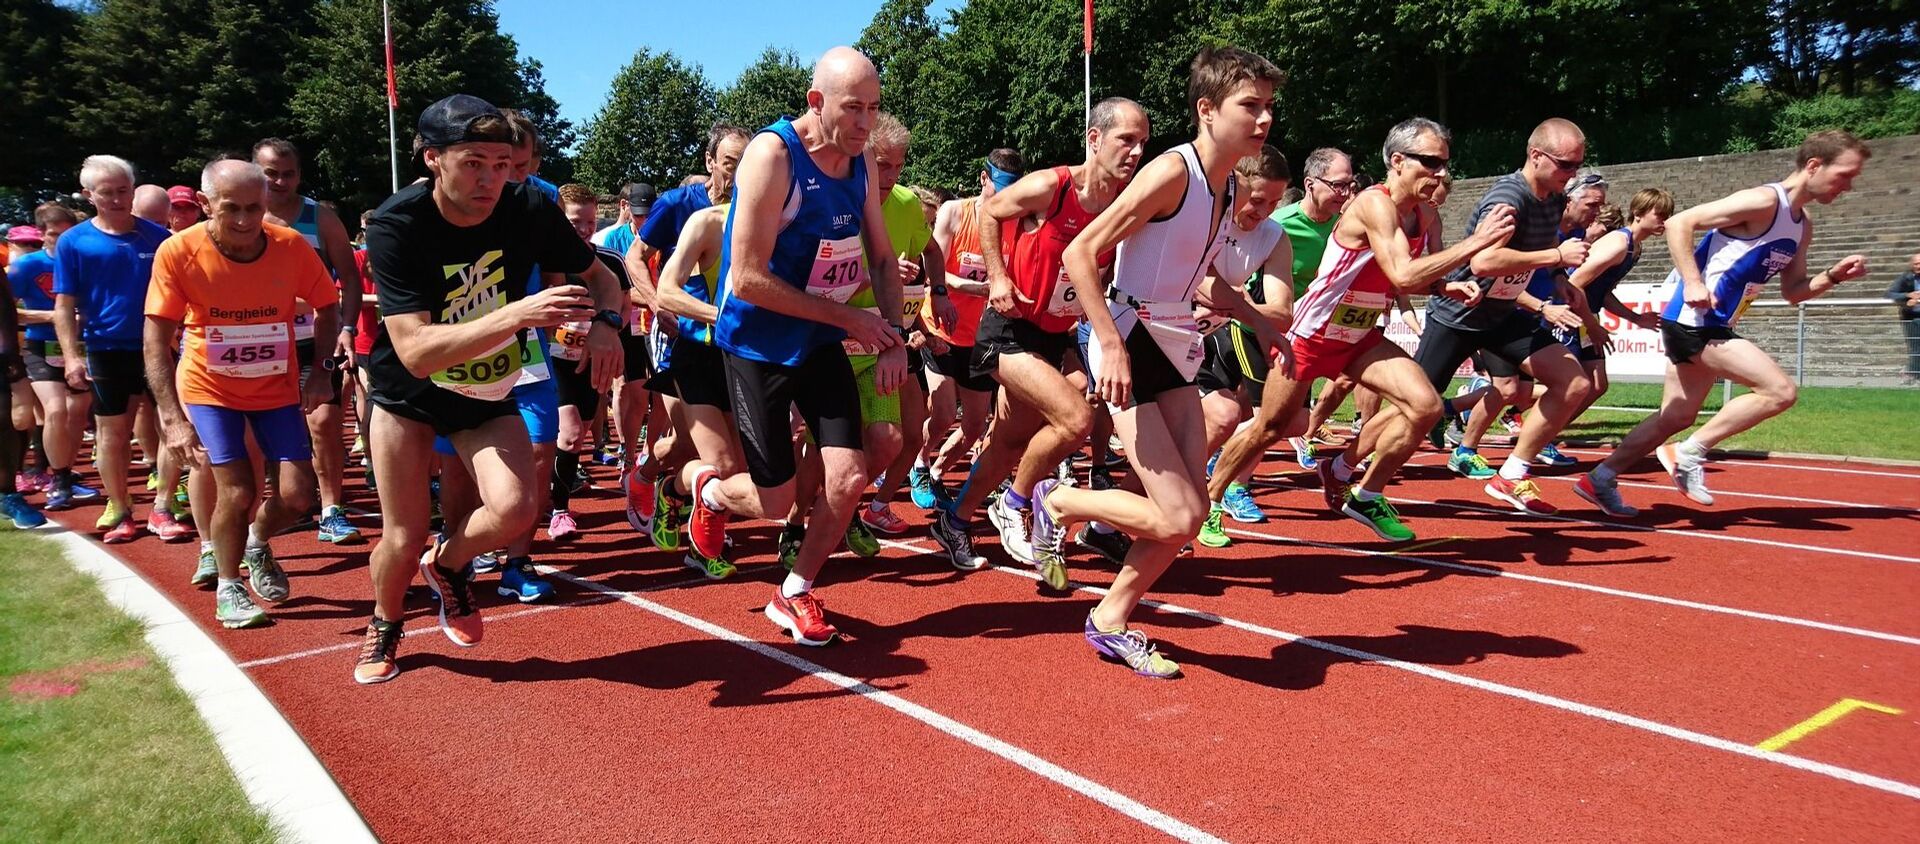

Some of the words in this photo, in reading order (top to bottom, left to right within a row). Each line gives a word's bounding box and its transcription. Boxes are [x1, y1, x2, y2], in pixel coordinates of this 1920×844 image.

[823, 260, 859, 285] 470
[209, 305, 278, 321] Bergheide
[1341, 308, 1377, 327] 541
[221, 345, 277, 363] 455
[446, 353, 510, 382] 509
